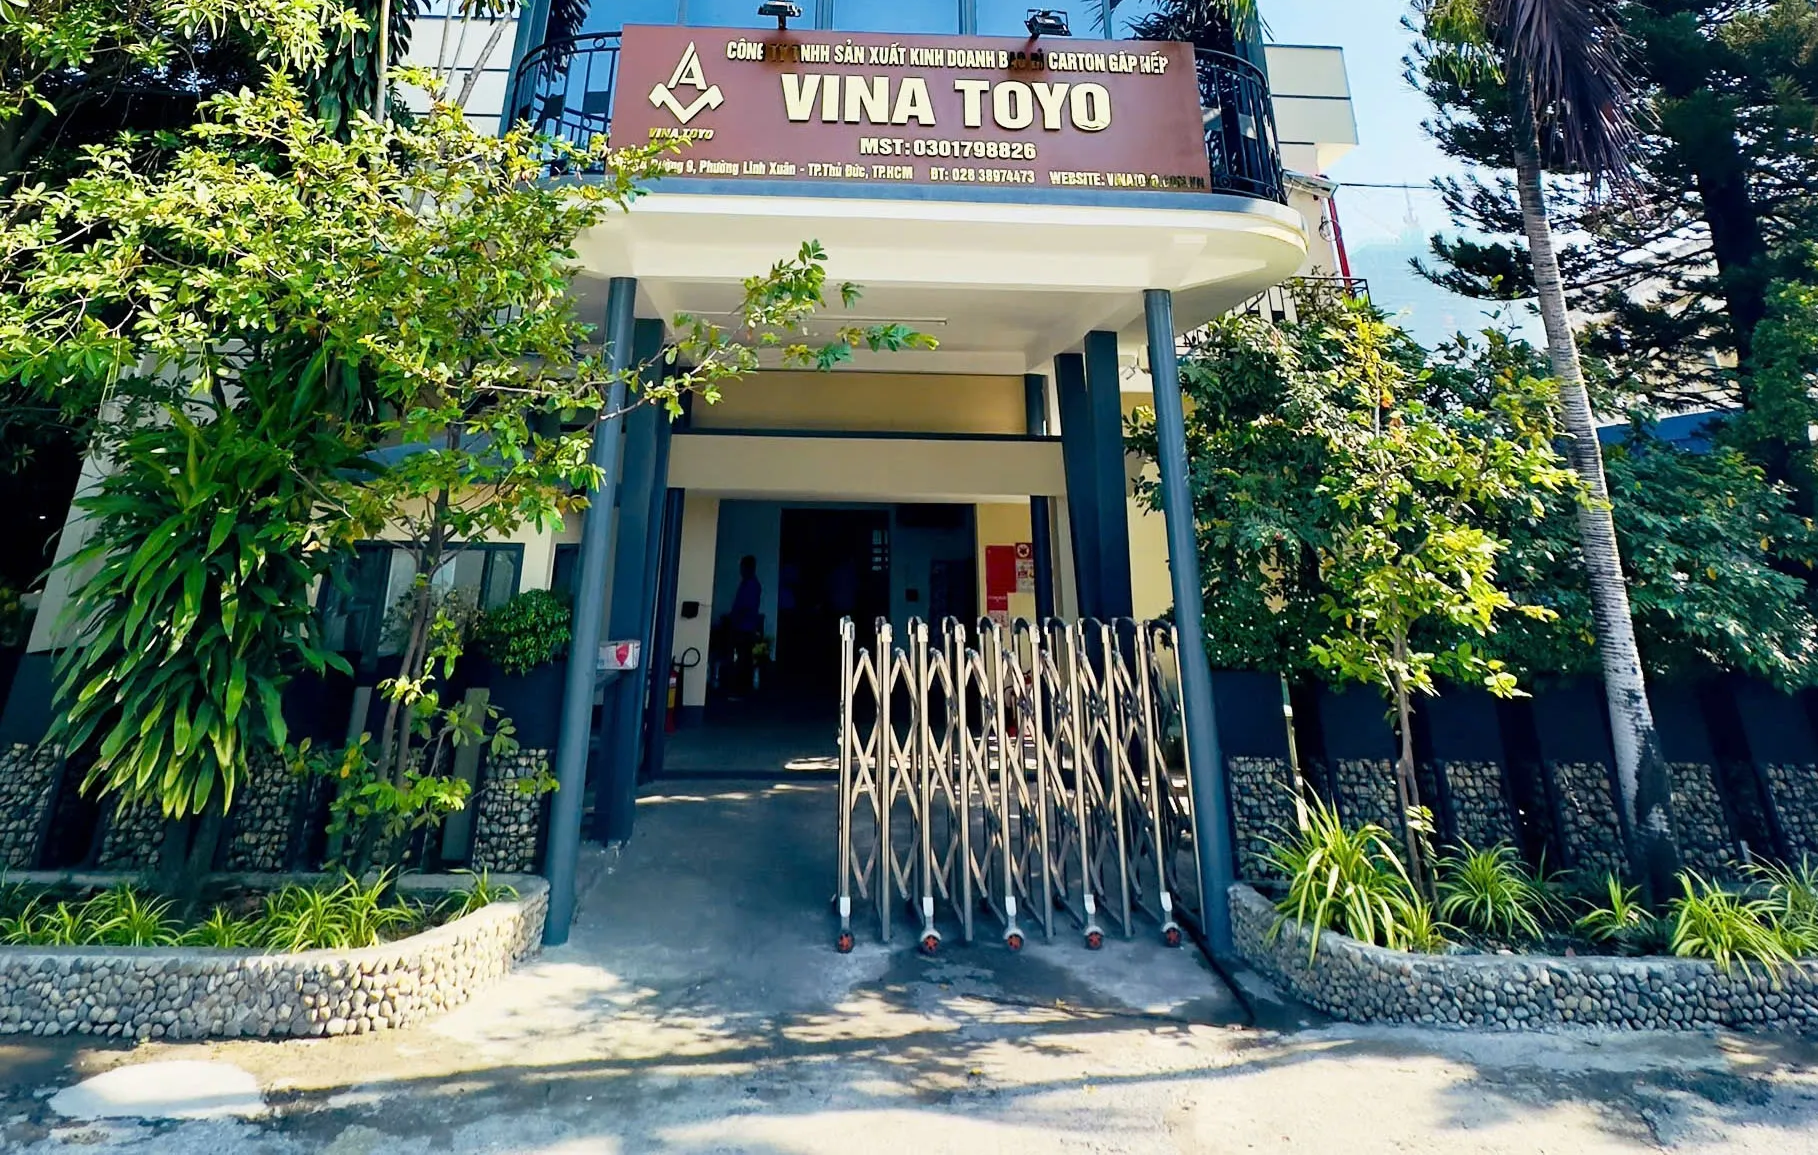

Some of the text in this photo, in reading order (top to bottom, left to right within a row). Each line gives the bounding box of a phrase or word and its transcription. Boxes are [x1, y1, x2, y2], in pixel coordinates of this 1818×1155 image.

[727, 38, 765, 60] CÔNG
[834, 39, 865, 64] SẢN
[869, 43, 906, 65] XUẤT
[910, 48, 944, 66] KINH
[947, 49, 995, 68] DOANH
[1048, 51, 1105, 72] CARTON
[1140, 50, 1169, 74] NẾP
[781, 73, 1112, 131] VINA TOYO
[648, 127, 714, 141] VINA TOYO
[686, 159, 697, 175] 9,
[699, 159, 739, 175] Phường
[769, 161, 796, 176] Xuân
[845, 164, 869, 179] Đức,
[872, 165, 913, 180] TP.HCM
[930, 167, 1035, 184] ĐT: 028 38974473
[1050, 171, 1105, 186] WEBSITE:
